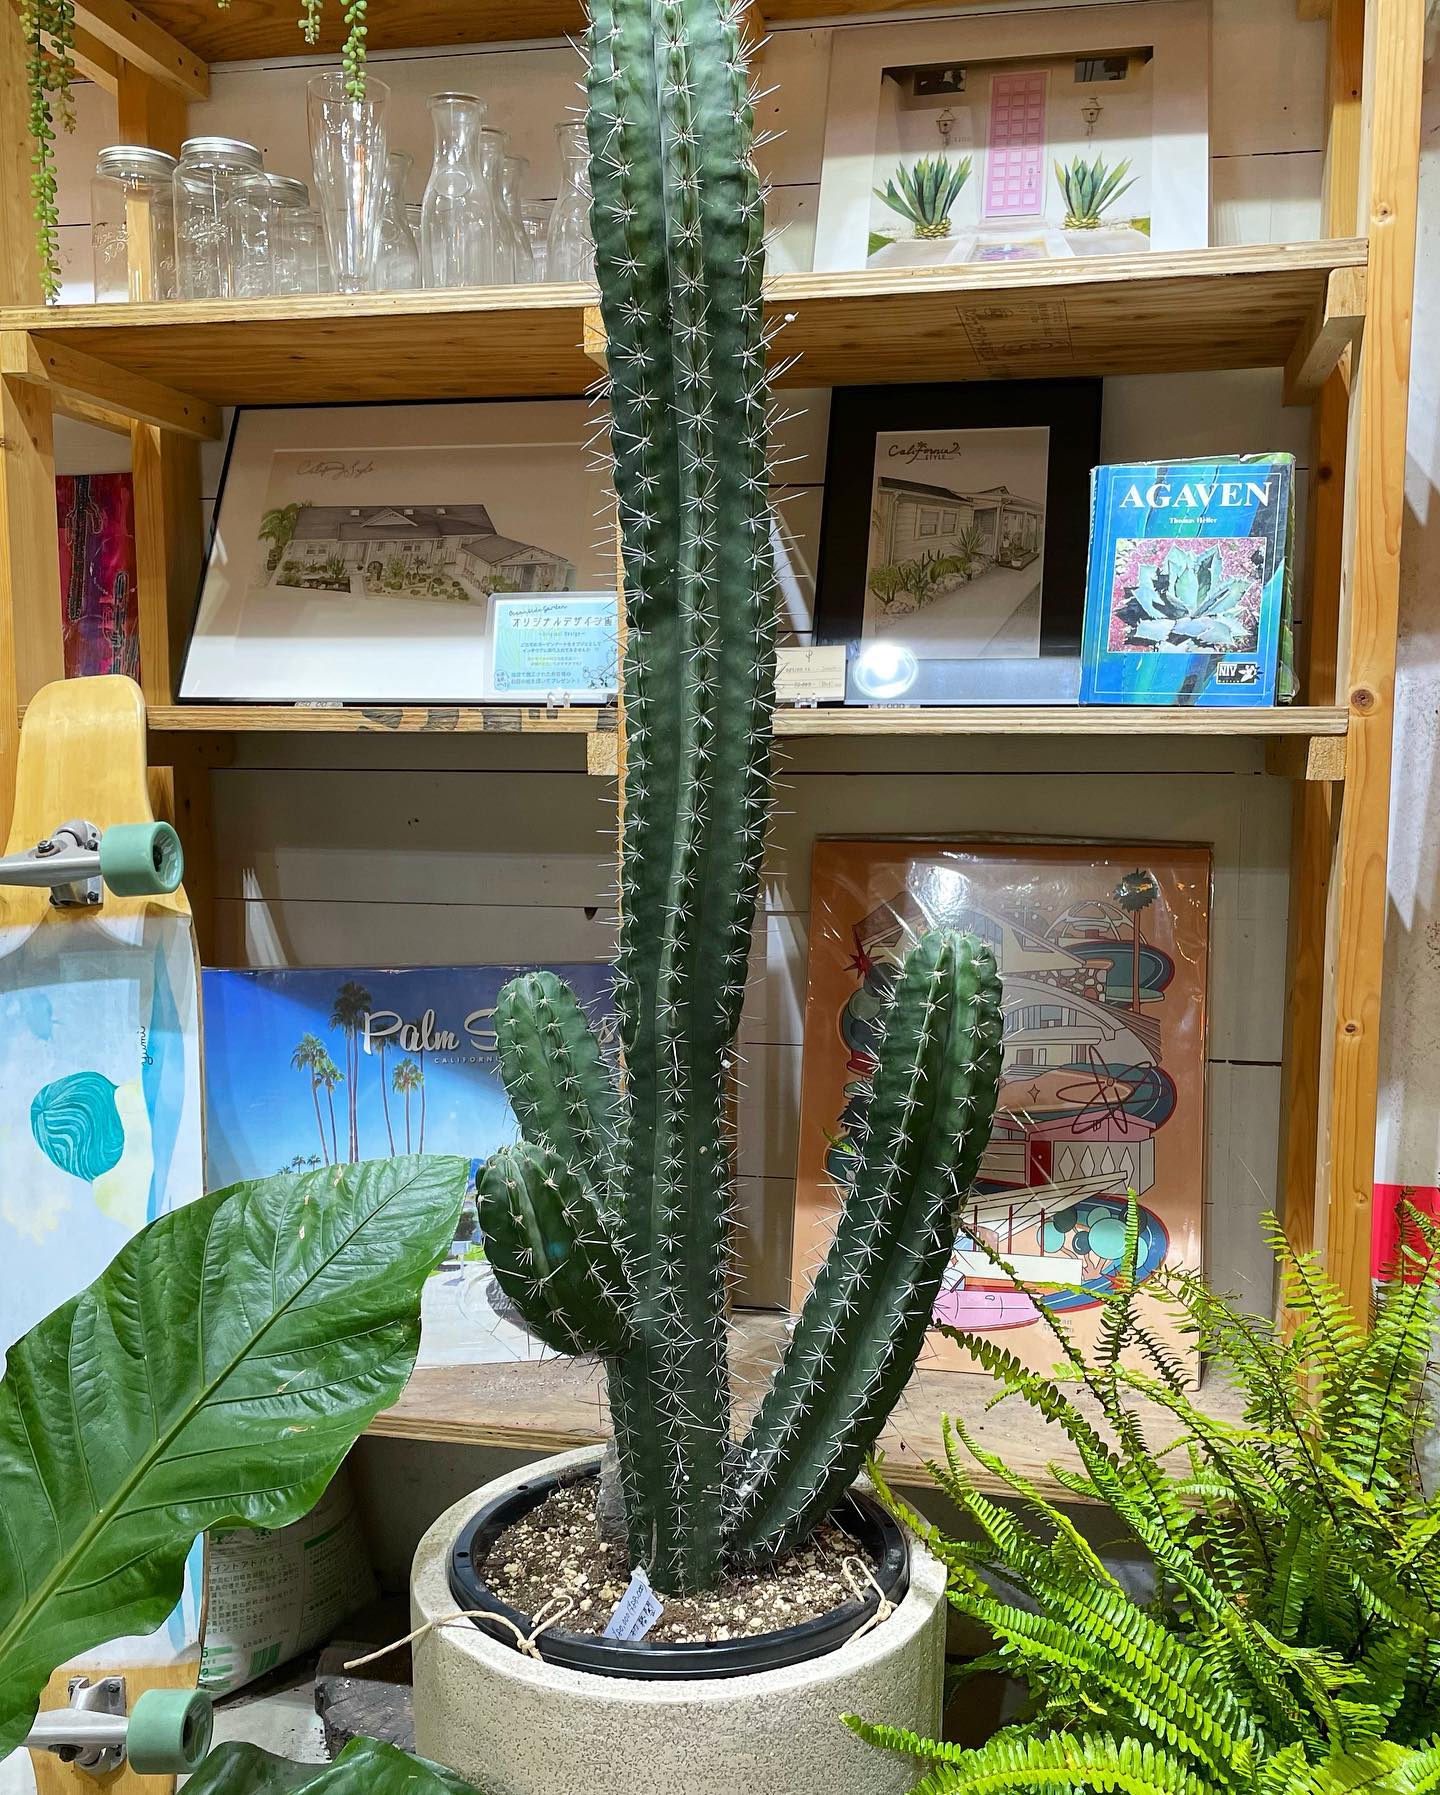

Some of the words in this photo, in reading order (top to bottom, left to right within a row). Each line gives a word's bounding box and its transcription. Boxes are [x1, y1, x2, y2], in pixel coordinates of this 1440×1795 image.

[1119, 481, 1272, 508] AGAVEN
[361, 1008, 460, 1055] Palm
[209, 1553, 284, 1573] イントアドバイス
